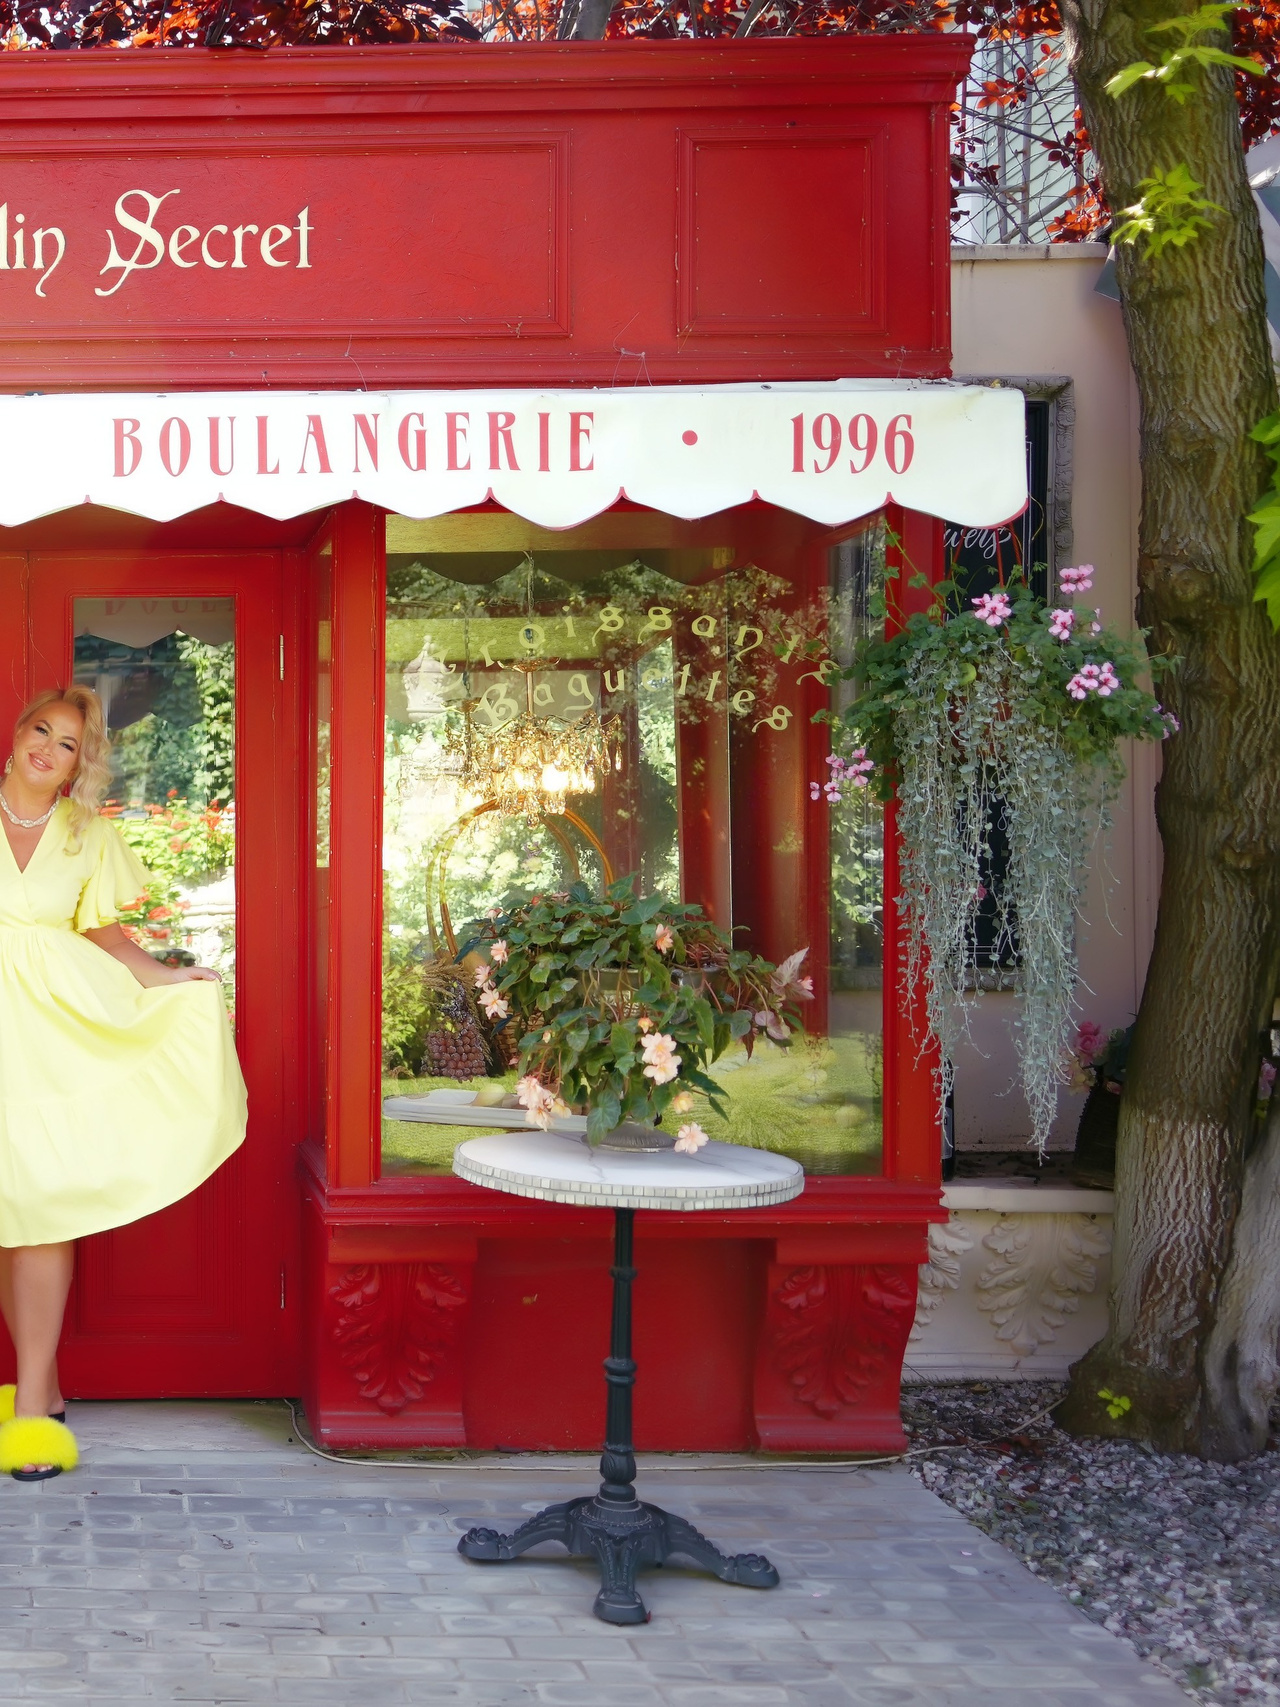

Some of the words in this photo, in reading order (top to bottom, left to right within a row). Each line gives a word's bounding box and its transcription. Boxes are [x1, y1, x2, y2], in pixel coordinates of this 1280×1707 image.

[95, 189, 314, 296] Secret
[112, 411, 595, 478] BOULANGERIE
[790, 411, 915, 475] 1996
[474, 664, 794, 732] Baguettes
